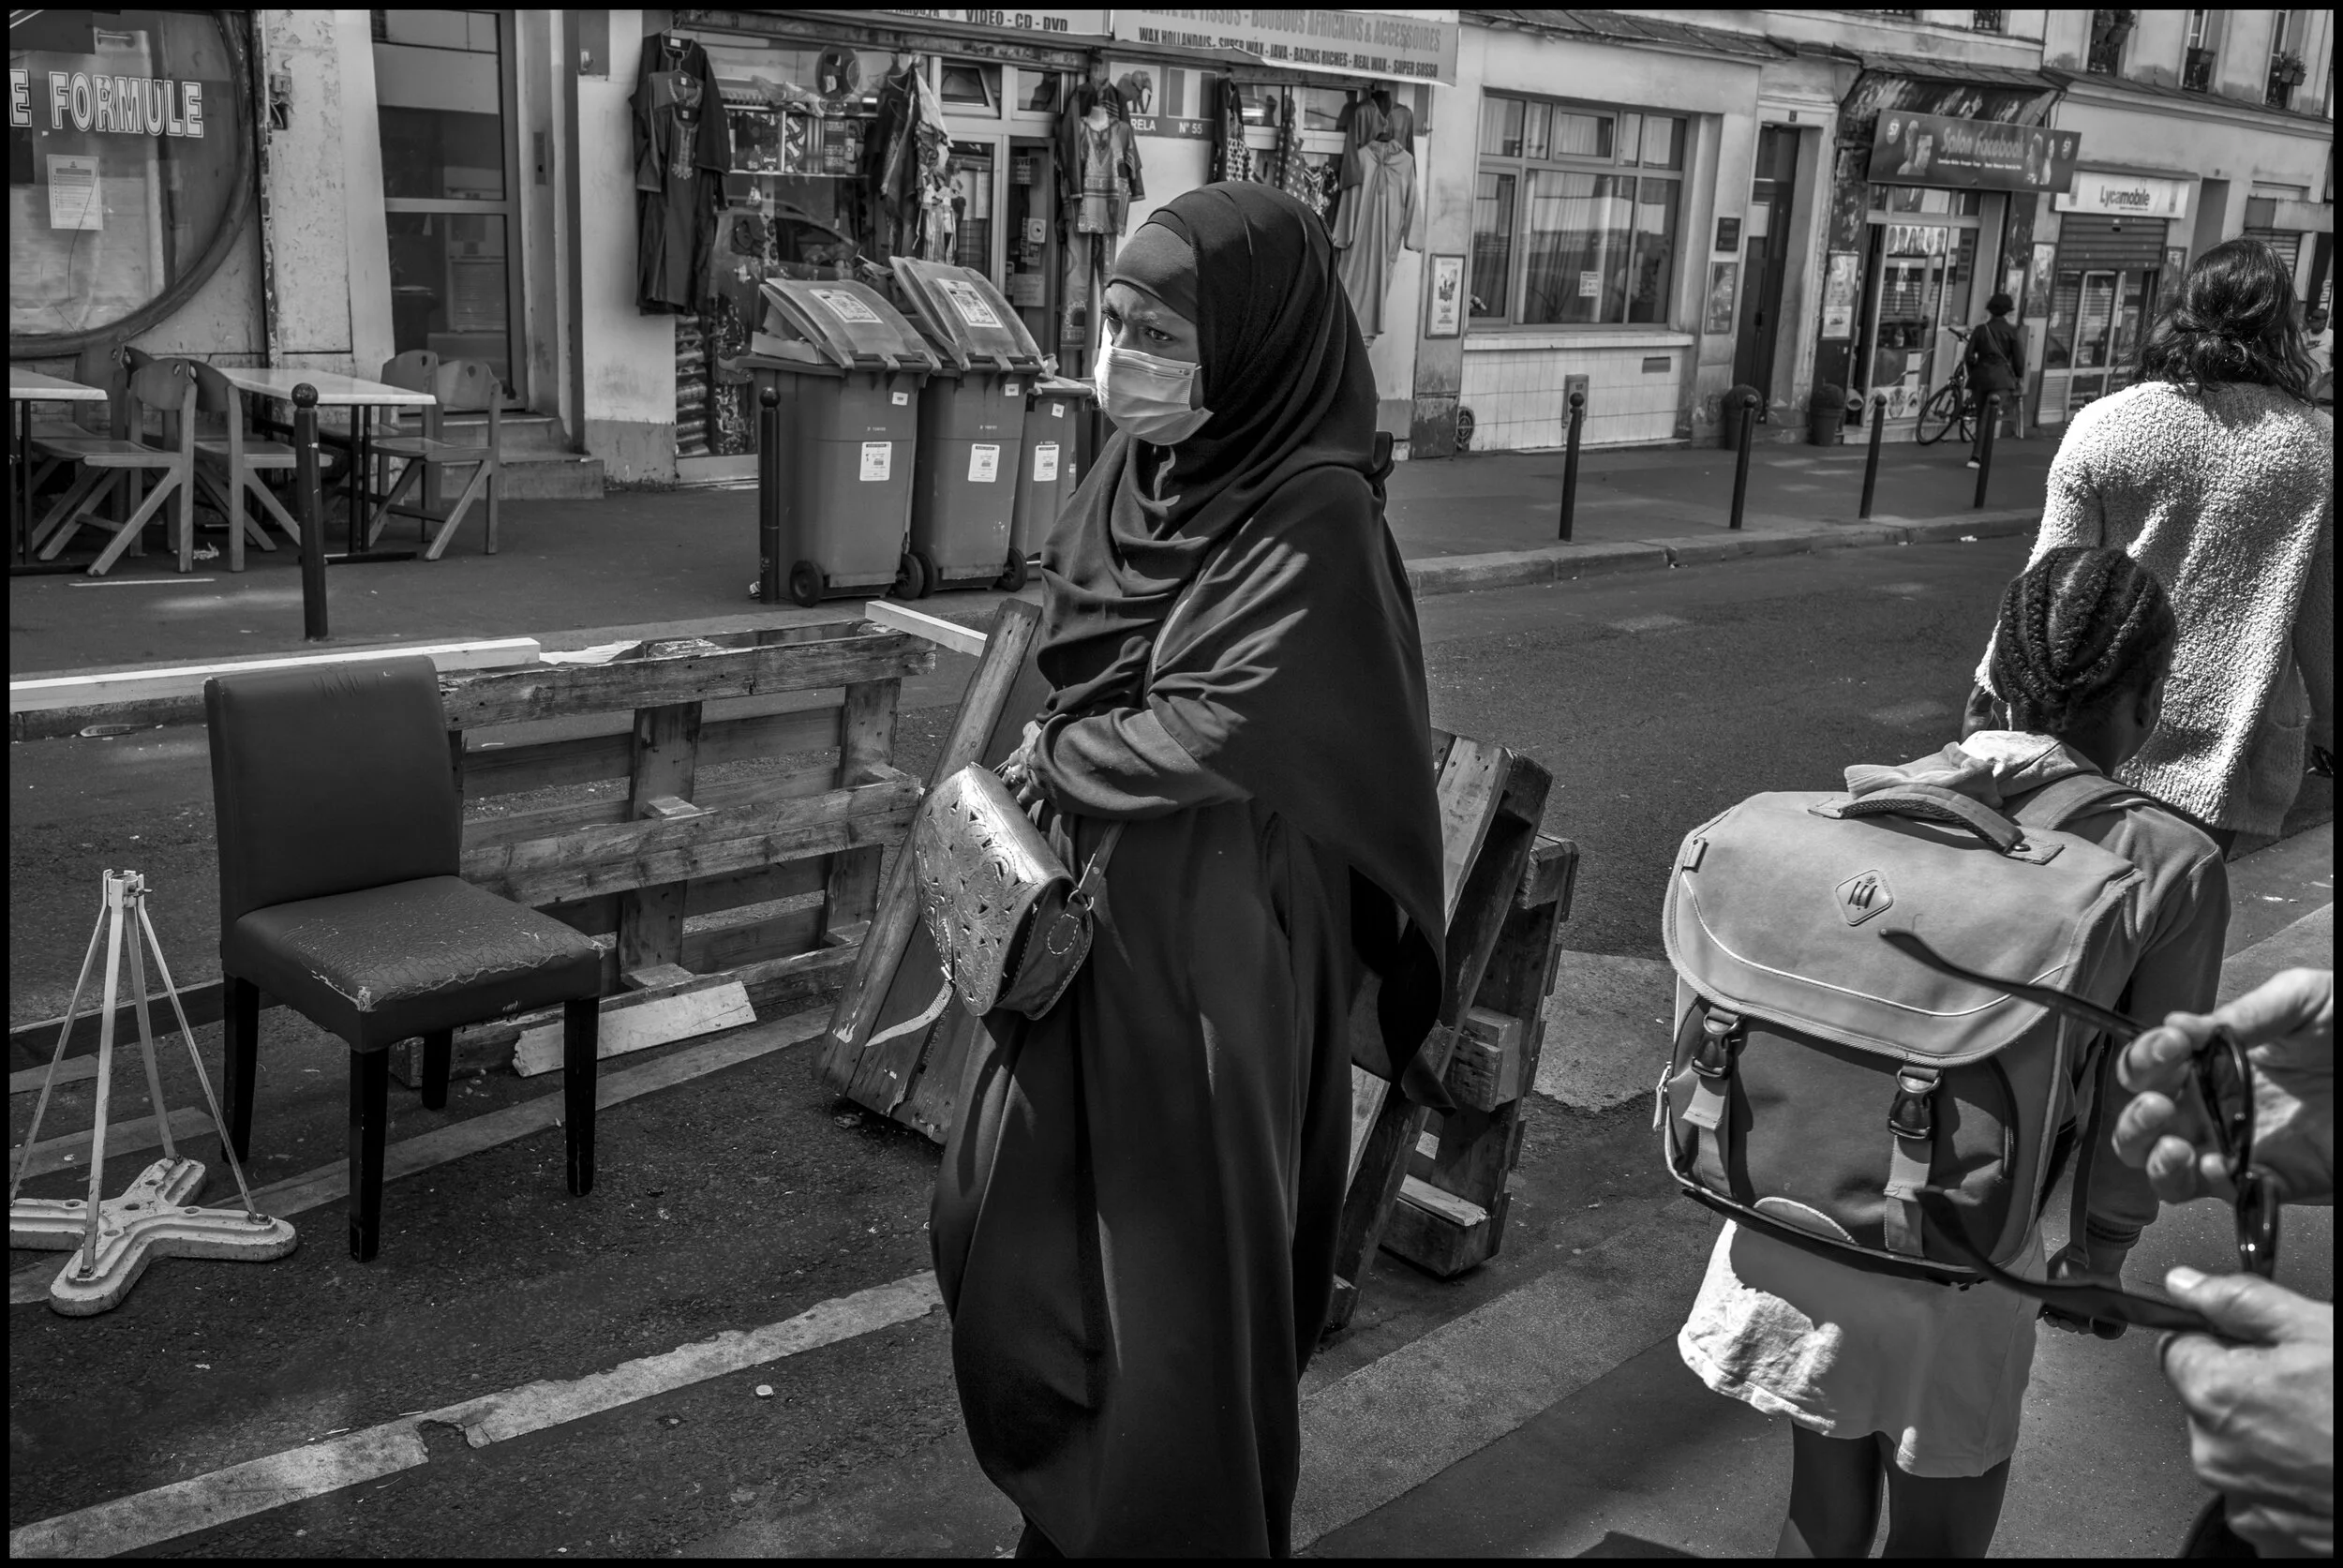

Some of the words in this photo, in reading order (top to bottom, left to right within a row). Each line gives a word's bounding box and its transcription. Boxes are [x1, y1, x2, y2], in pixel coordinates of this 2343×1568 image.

[965, 10, 1004, 25] VIDEO
[1015, 12, 1033, 28] CD
[1043, 16, 1067, 32] DVD
[1251, 10, 1306, 34] BOUBOUS
[1306, 10, 1364, 43] AFRICAINS
[1365, 22, 1372, 43] &
[1373, 20, 1440, 53] ACCESSOIRES
[1139, 27, 1159, 43] WAX
[1161, 30, 1212, 48] HOLLANDAIS
[1218, 37, 1245, 50] SUPER
[1246, 41, 1264, 56] WAX
[1270, 44, 1288, 60] JAVA
[1293, 47, 1320, 65] BAZINS
[1321, 50, 1348, 67] RICHES
[1353, 54, 1369, 70] REAL
[1371, 56, 1388, 72] WAX
[1394, 60, 1415, 76] SUPER
[1416, 63, 1439, 78] SOSSO
[10, 68, 32, 127] E
[49, 71, 204, 138] FORMULE
[1129, 118, 1157, 131] RELA
[1191, 123, 1203, 135] 55
[1974, 130, 2025, 158] Facebook
[2099, 185, 2151, 207] Lycamobile
